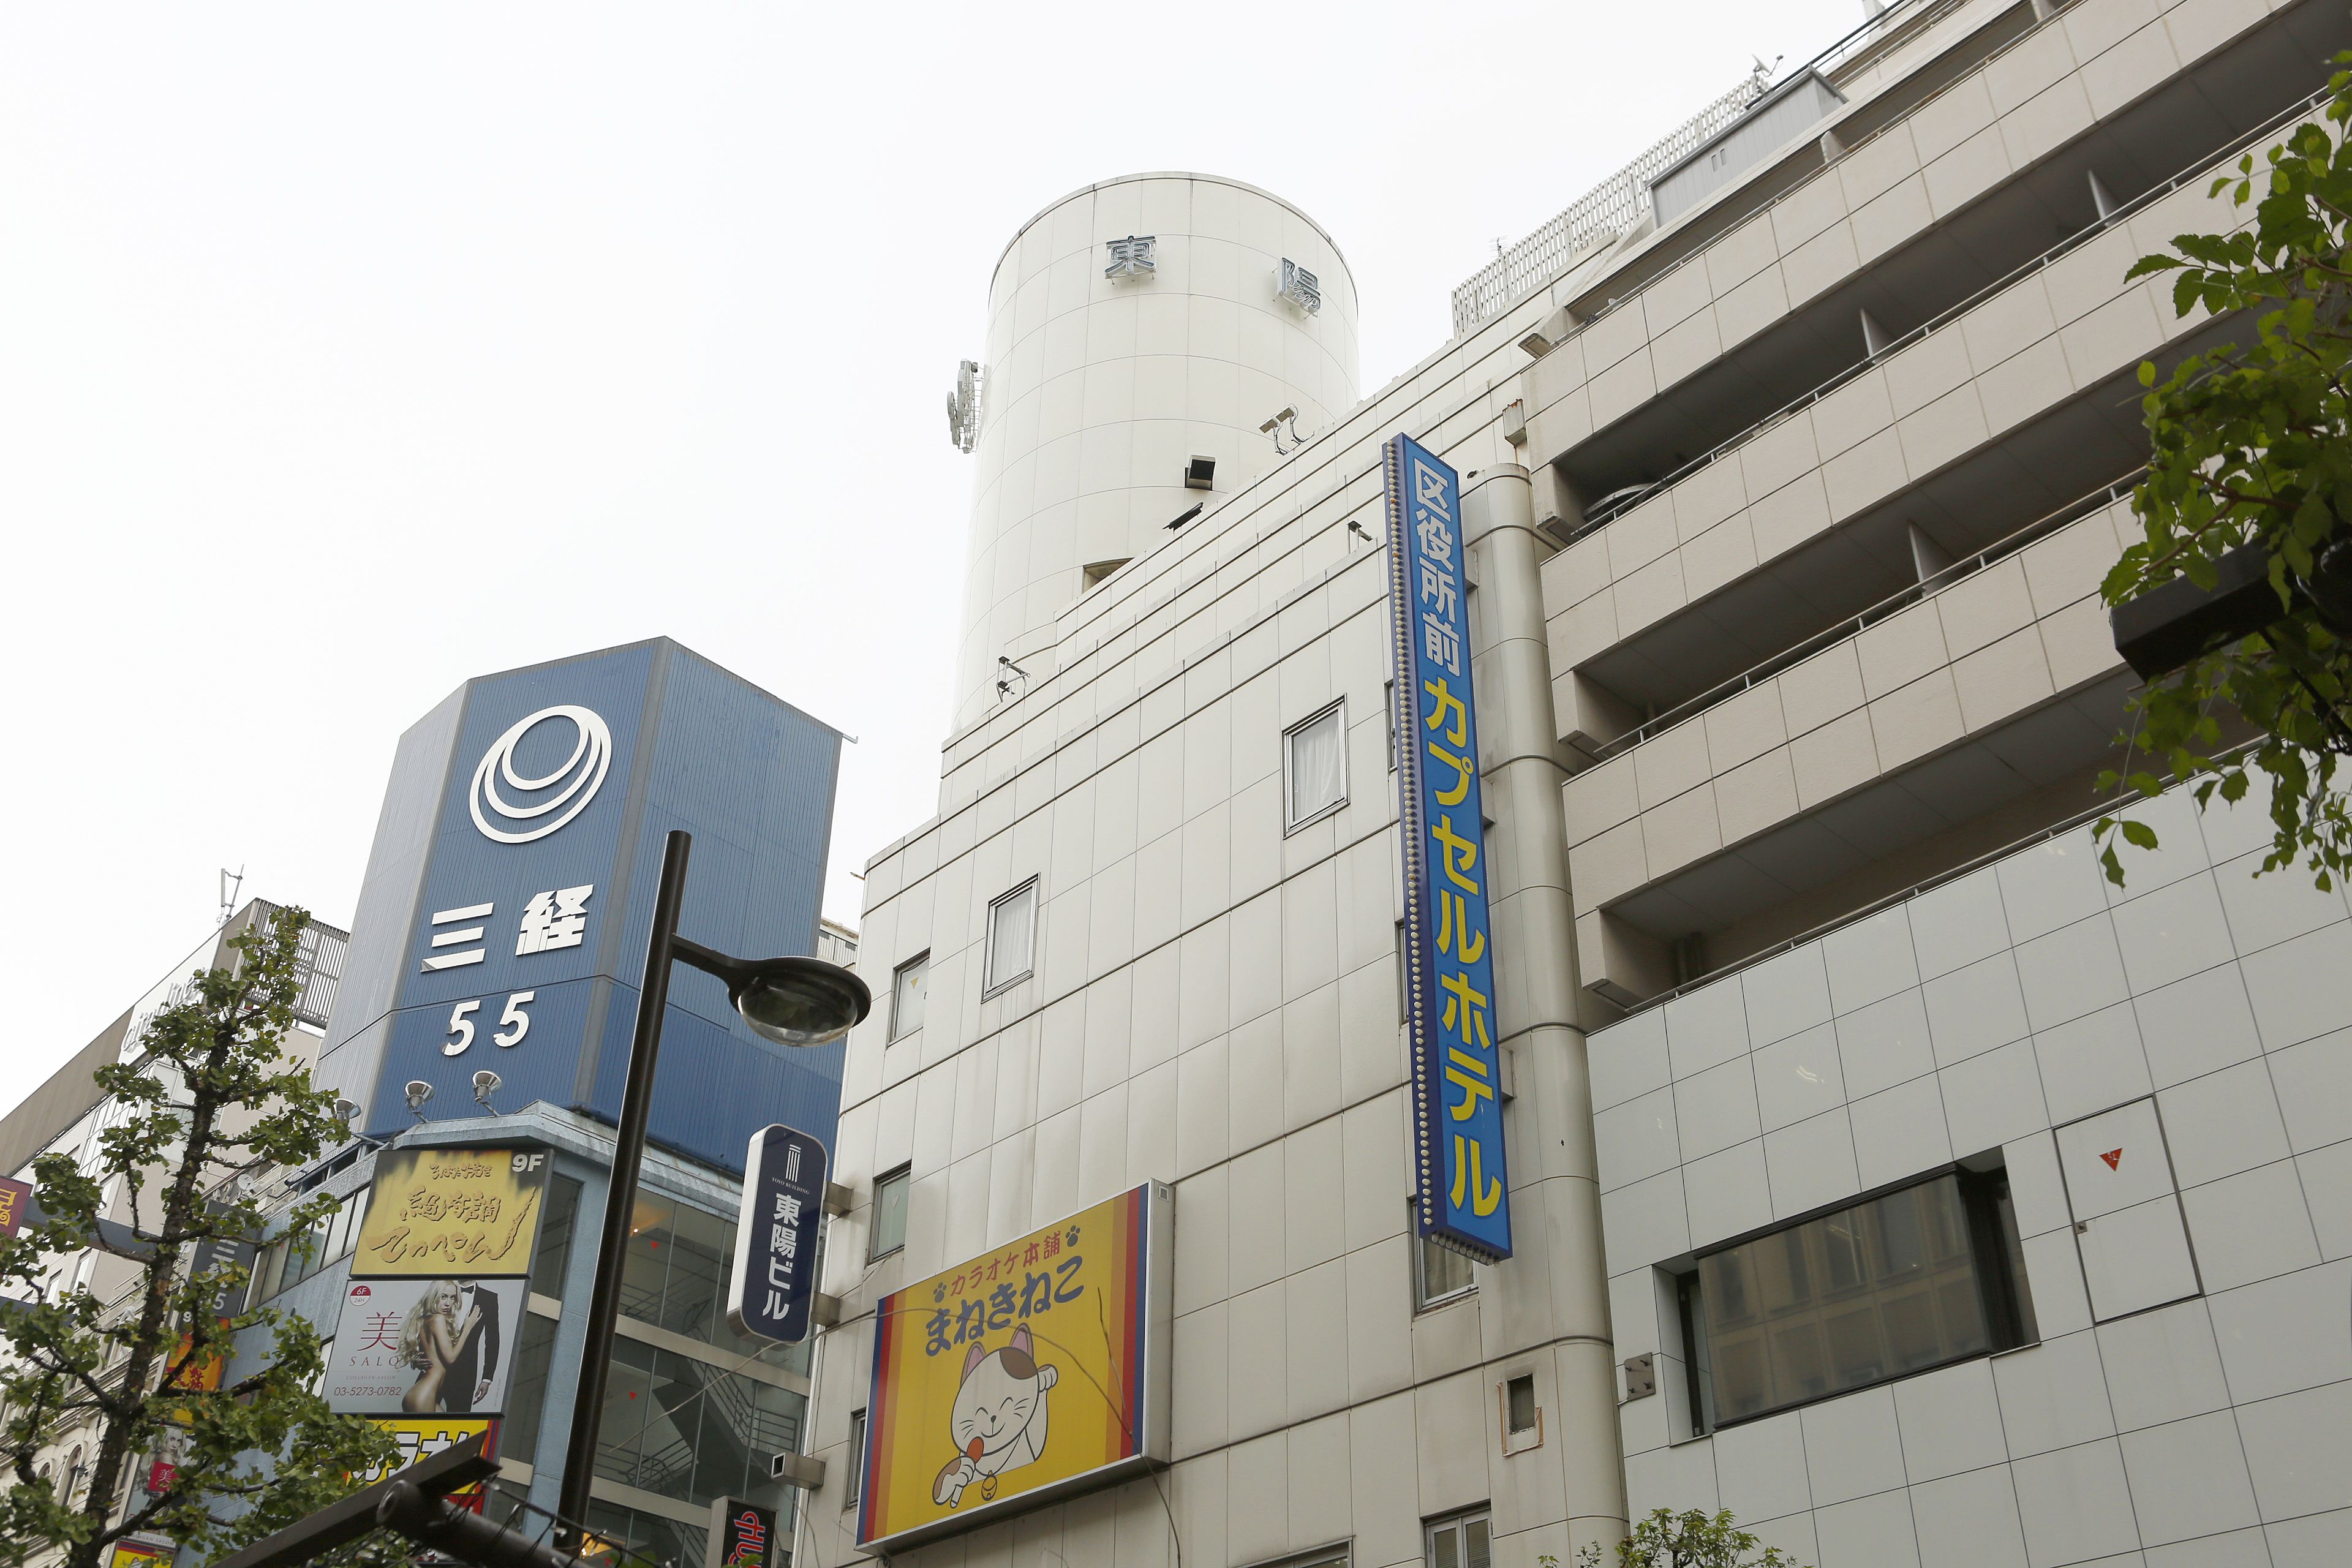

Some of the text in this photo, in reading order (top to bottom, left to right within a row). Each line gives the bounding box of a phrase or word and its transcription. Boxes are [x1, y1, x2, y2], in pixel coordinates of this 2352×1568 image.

[420, 884, 594, 973] 三経
[441, 990, 535, 1057] 55
[511, 1154, 545, 1172] 9F
[772, 1177, 809, 1195] TOYO BUILDING
[762, 1193, 802, 1321] 東陽ビル
[951, 1229, 1061, 1297] カラオケ本舗
[357, 1311, 402, 1352] 美
[925, 1256, 1085, 1357] まねきねこ
[334, 1387, 402, 1396] 03-5273-0782
